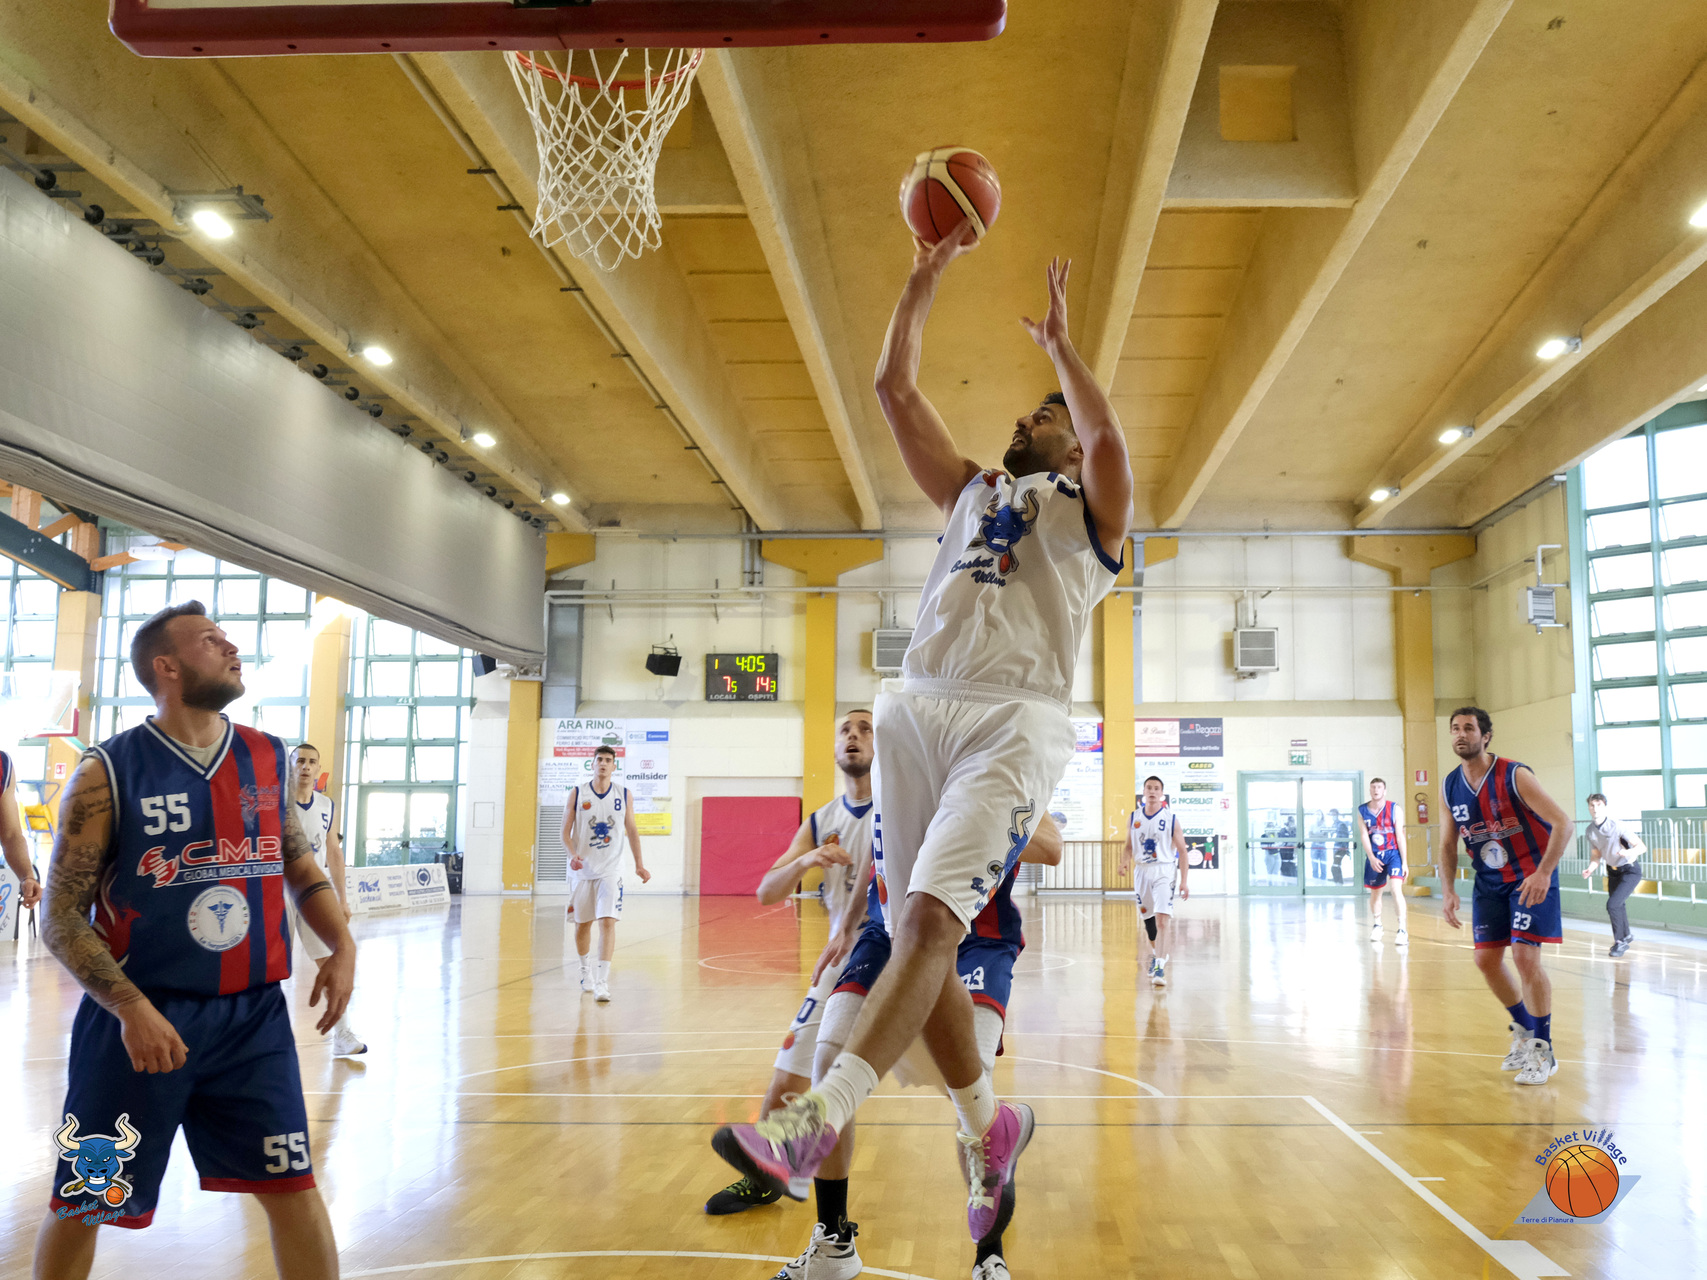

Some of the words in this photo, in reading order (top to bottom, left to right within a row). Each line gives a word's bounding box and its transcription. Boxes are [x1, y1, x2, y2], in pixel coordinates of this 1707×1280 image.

[736, 655, 766, 672] 4:05
[558, 720, 583, 729] ARA
[585, 720, 614, 729] RINO
[626, 772, 668, 780] emilsider
[614, 798, 622, 811] 8
[1452, 804, 1470, 821] 23
[140, 792, 192, 836] 55
[321, 812, 329, 830] 5
[1158, 819, 1166, 831] 9
[183, 868, 217, 881] GLOBAL
[219, 867, 252, 878] MEDICAL
[252, 863, 283, 875] DIVISION
[1391, 867, 1401, 876] 17
[1513, 911, 1531, 931] 23
[263, 1131, 311, 1174] 55
